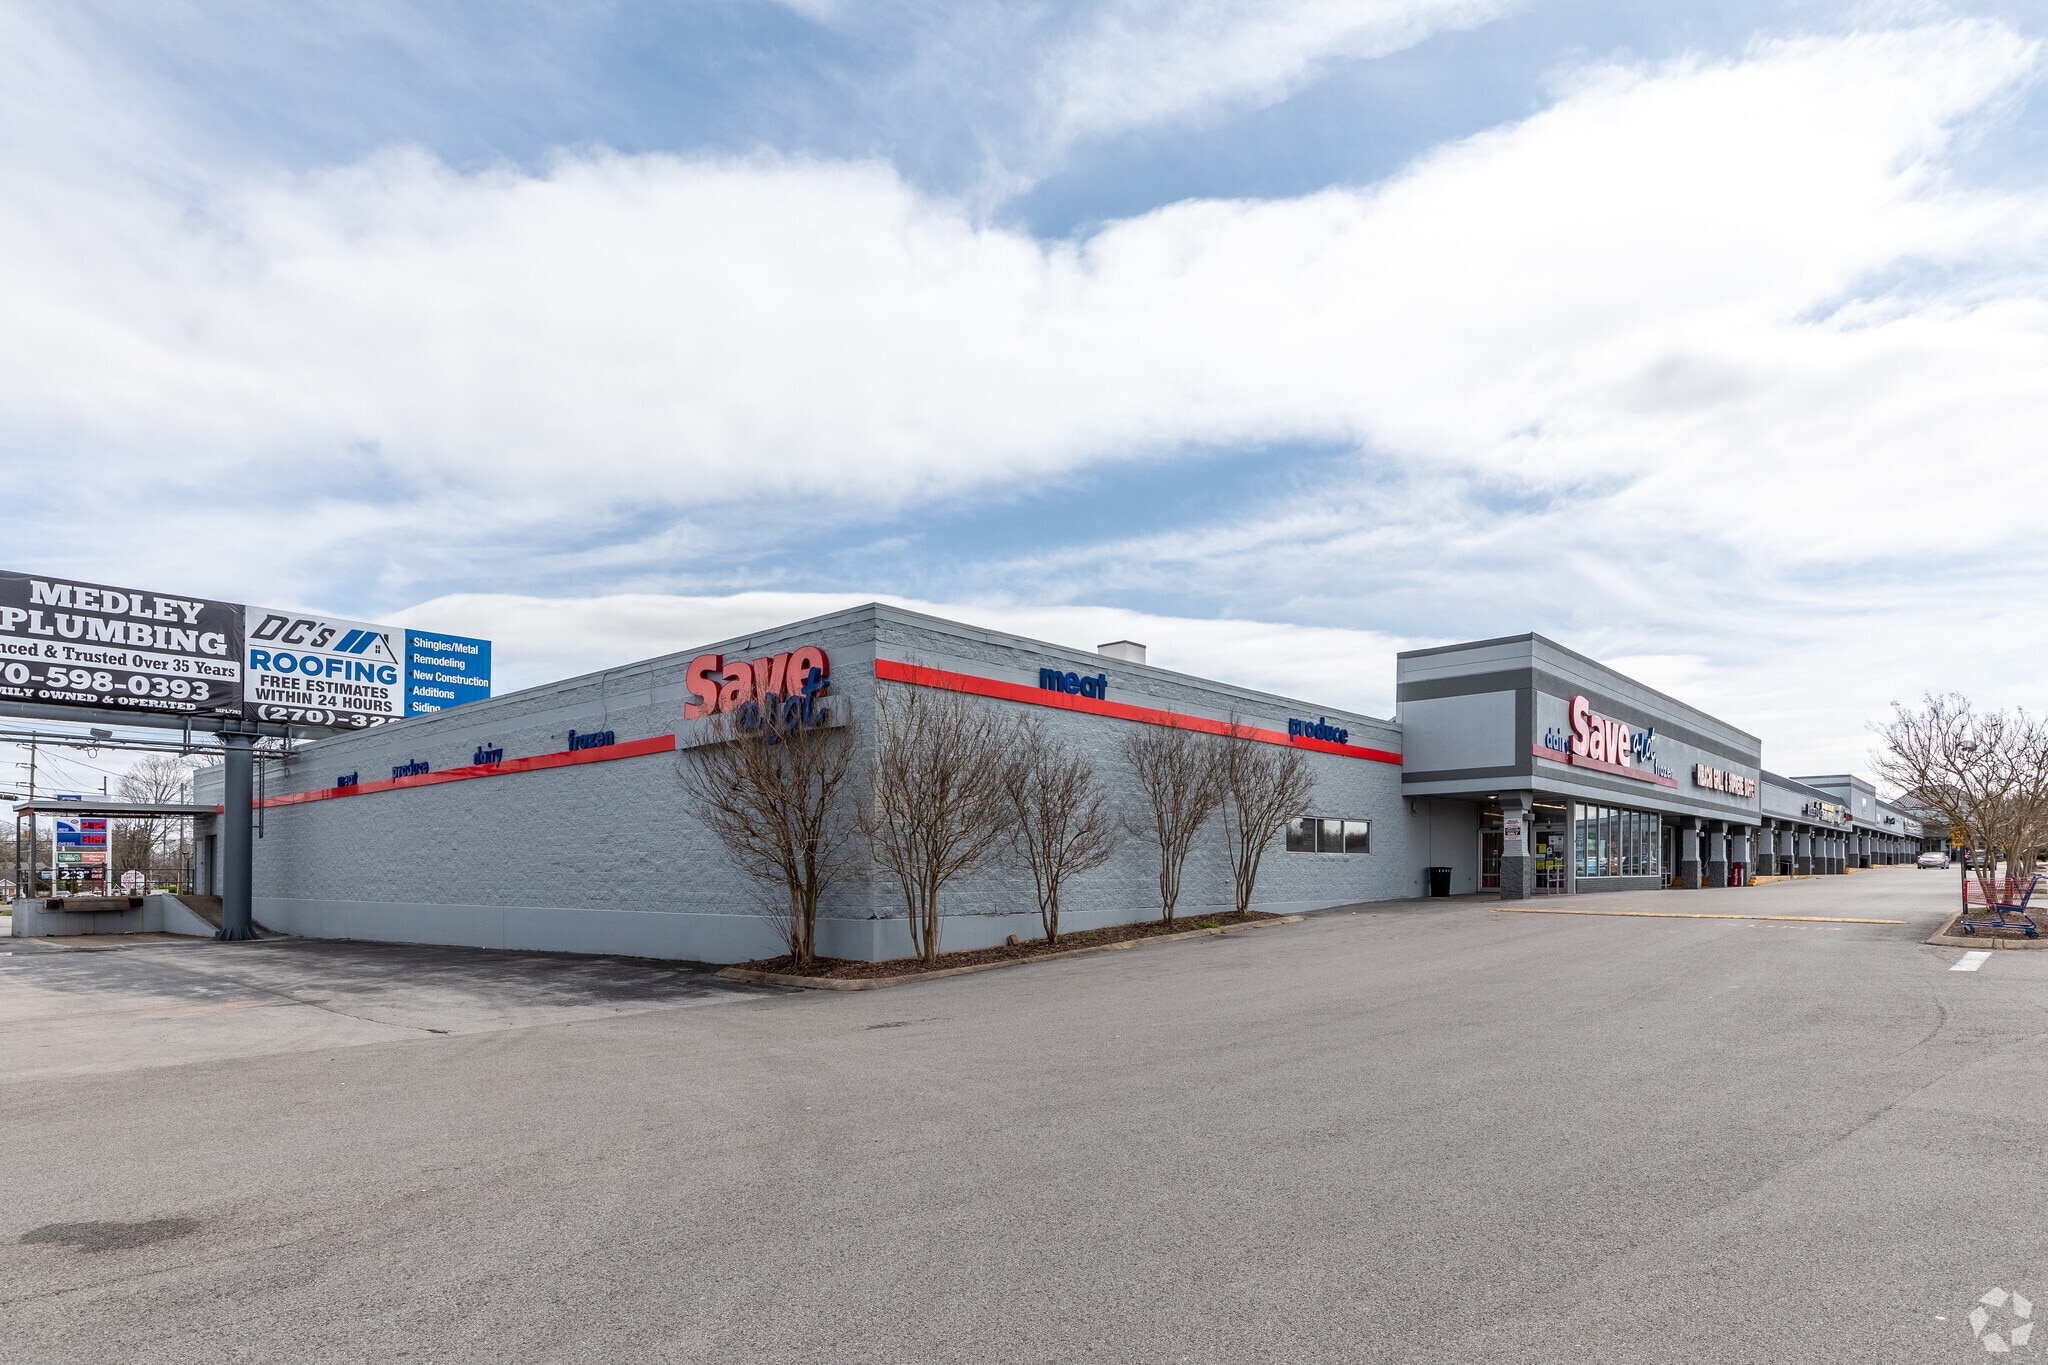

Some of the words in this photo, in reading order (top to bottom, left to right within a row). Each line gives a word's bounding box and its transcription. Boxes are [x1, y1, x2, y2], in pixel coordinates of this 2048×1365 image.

[30, 580, 204, 624] MEDLEY
[0, 606, 228, 656] PLUMBING
[250, 614, 336, 648] DC's
[413, 637, 479, 655] Shingles/Metal
[44, 645, 58, 658] &
[62, 646, 127, 666] Trusted
[132, 655, 169, 670] Over
[173, 659, 190, 672] 35
[194, 661, 235, 677] Years
[250, 649, 397, 685] ROOFING
[413, 653, 466, 671] Remodeling
[0, 662, 210, 701] 0-598-0393
[260, 674, 300, 690] FREE
[306, 679, 389, 699] ESTIMATES
[413, 669, 434, 681] New
[435, 671, 489, 688] Construction
[684, 645, 830, 720] Save
[1040, 667, 1108, 700] meat
[38, 690, 98, 703] OWNED
[102, 695, 114, 704] &
[117, 696, 197, 711] OPERATED
[255, 687, 312, 705] WITHIN
[318, 694, 337, 707] 24
[342, 697, 393, 713] HOURS
[412, 685, 455, 700] Additions
[257, 704, 401, 728] (270)-32
[568, 729, 615, 751] frozen
[1289, 717, 1349, 744] produce
[1569, 695, 1631, 767] Save
[473, 742, 503, 768] dairy
[337, 772, 358, 787] meat
[392, 759, 430, 784] produce
